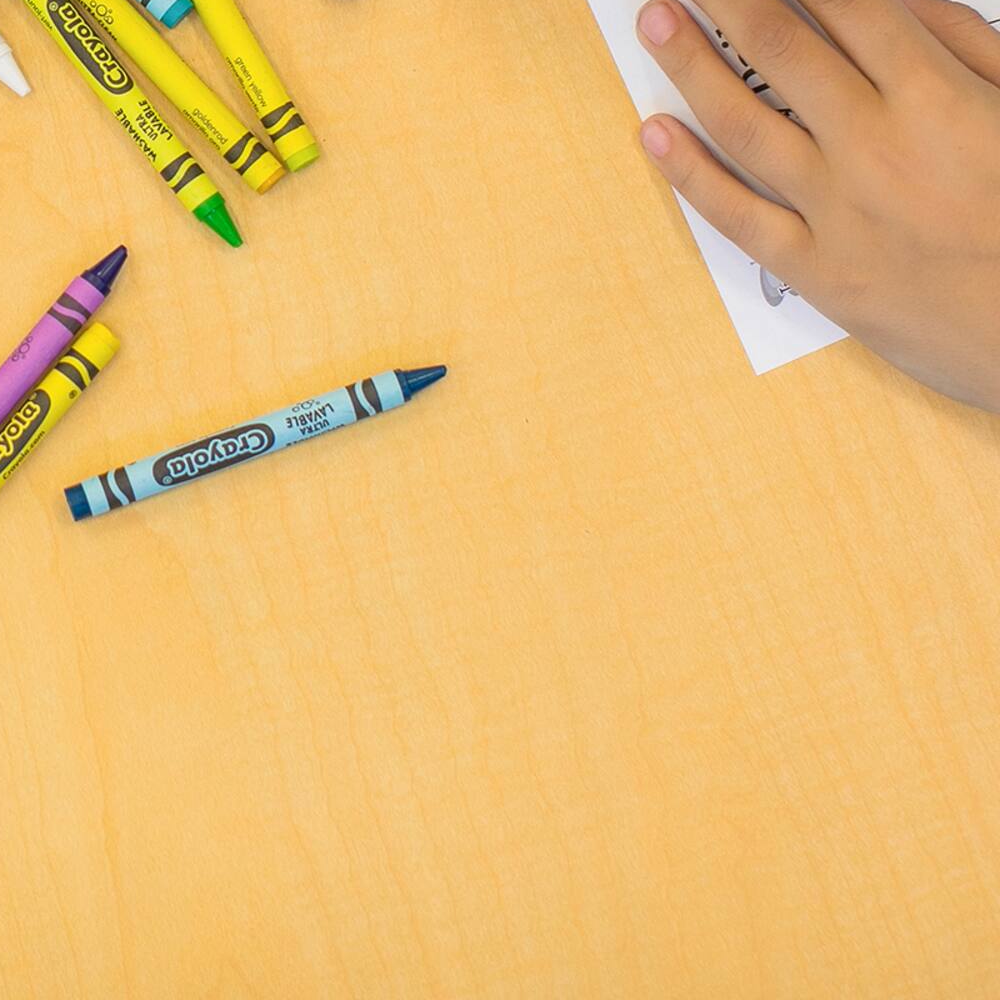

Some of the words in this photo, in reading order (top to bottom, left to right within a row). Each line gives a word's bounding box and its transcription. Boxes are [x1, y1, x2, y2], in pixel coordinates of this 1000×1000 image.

[60, 2, 128, 88] Crayola
[234, 56, 252, 82] green
[246, 79, 268, 108] yellow
[115, 107, 157, 162] WASHABLE
[136, 114, 158, 140] ULTRA
[138, 100, 173, 140] LAVABLE
[192, 108, 228, 146] goldenrod
[286, 402, 335, 429] LAVABLE
[300, 419, 329, 436] ULTRA
[169, 431, 266, 476] Crayola
